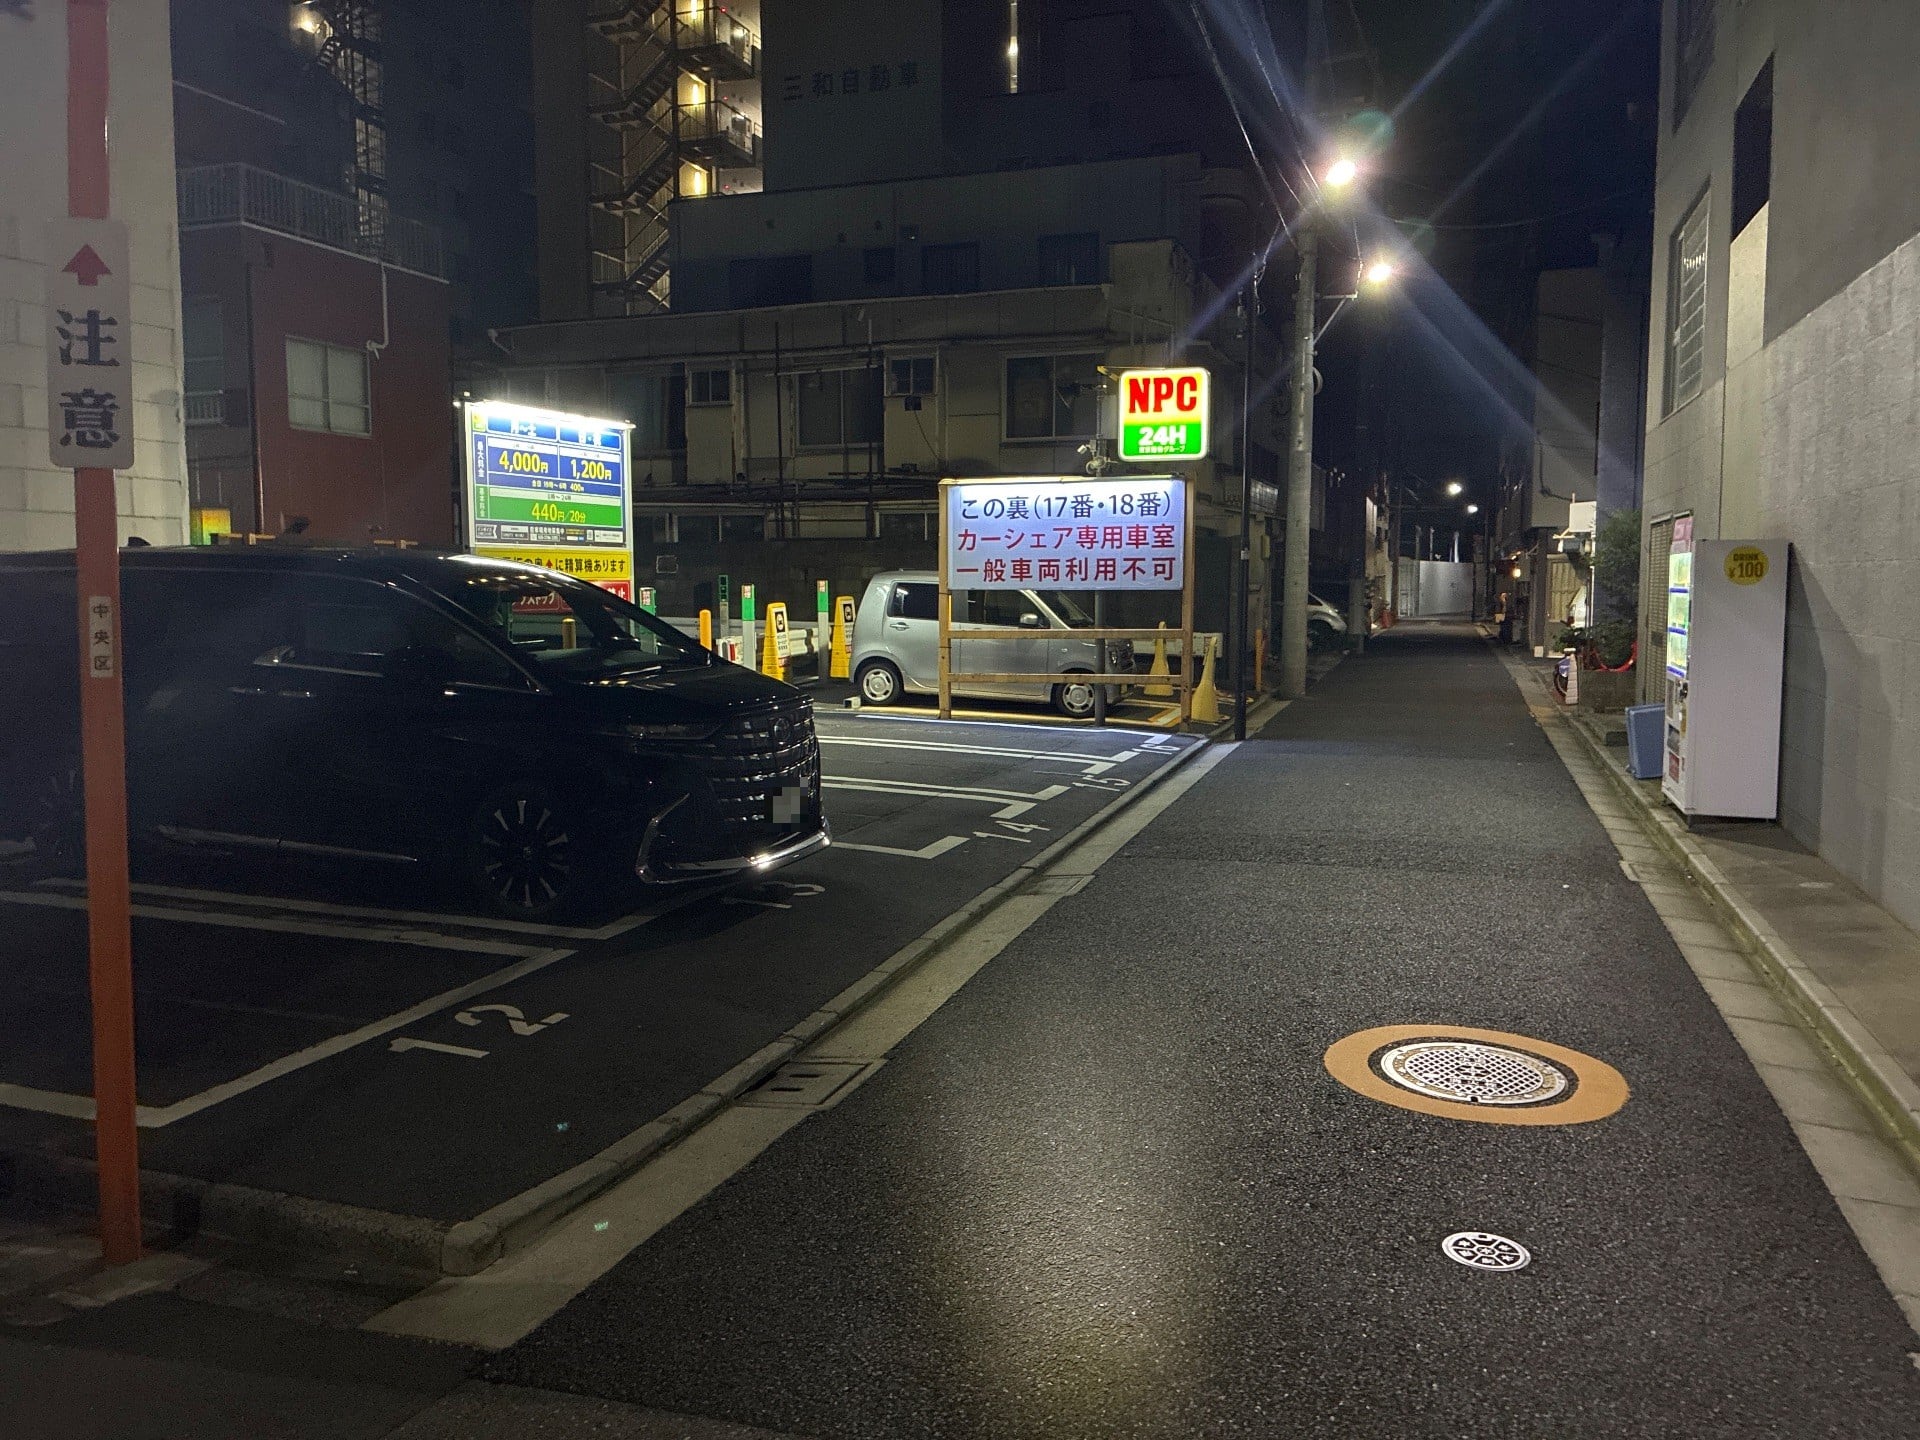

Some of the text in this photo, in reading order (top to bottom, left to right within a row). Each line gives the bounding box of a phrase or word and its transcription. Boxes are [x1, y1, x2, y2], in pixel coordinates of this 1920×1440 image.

[56, 309, 121, 449] 注意
[1128, 376, 1198, 414] NPC
[1138, 425, 1187, 446] 24H
[499, 450, 548, 474] 4,000円
[571, 459, 611, 481] 1,200円
[957, 523, 1175, 551] カーシェア専用車室
[957, 556, 1176, 582] 一般車両利用不可
[1733, 553, 1760, 561] DRINK
[93, 603, 111, 671] 中央区
[1132, 743, 1181, 755] 16
[1072, 775, 1131, 792] 15
[972, 820, 1051, 843] 14
[386, 1003, 571, 1059] 12
